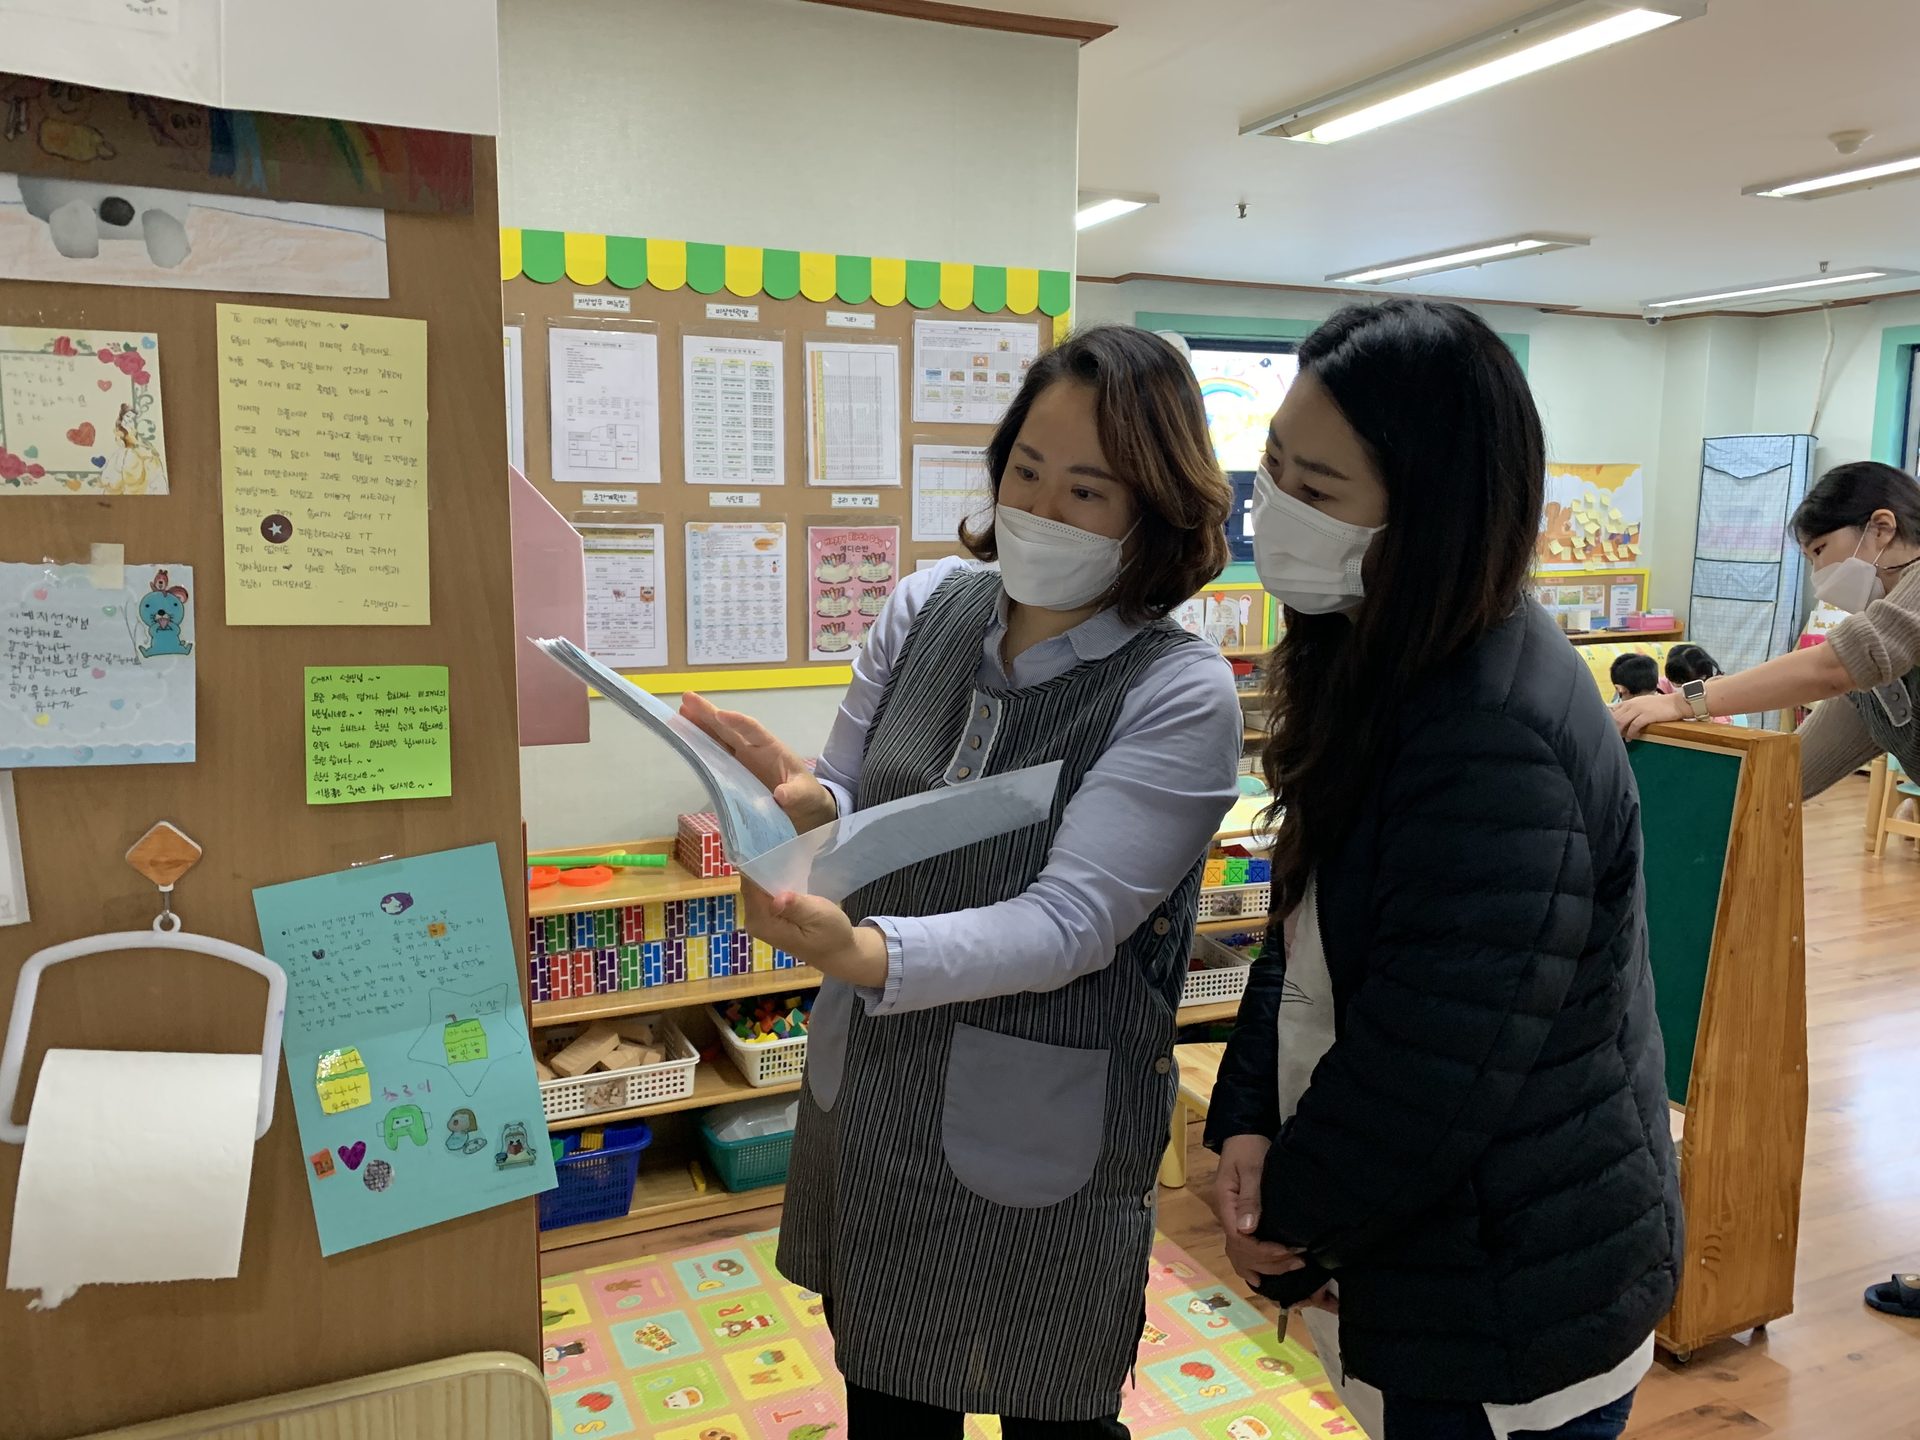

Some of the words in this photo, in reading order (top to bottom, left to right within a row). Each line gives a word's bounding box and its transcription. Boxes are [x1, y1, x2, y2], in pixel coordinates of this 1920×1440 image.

[715, 308, 749, 318] 비상연락망
[725, 495, 744, 504] 식단표
[840, 545, 869, 553] 에디슨반
[718, 1304, 745, 1317] R
[1199, 1383, 1229, 1398] S
[772, 1409, 803, 1424] T
[573, 1419, 607, 1434] S
